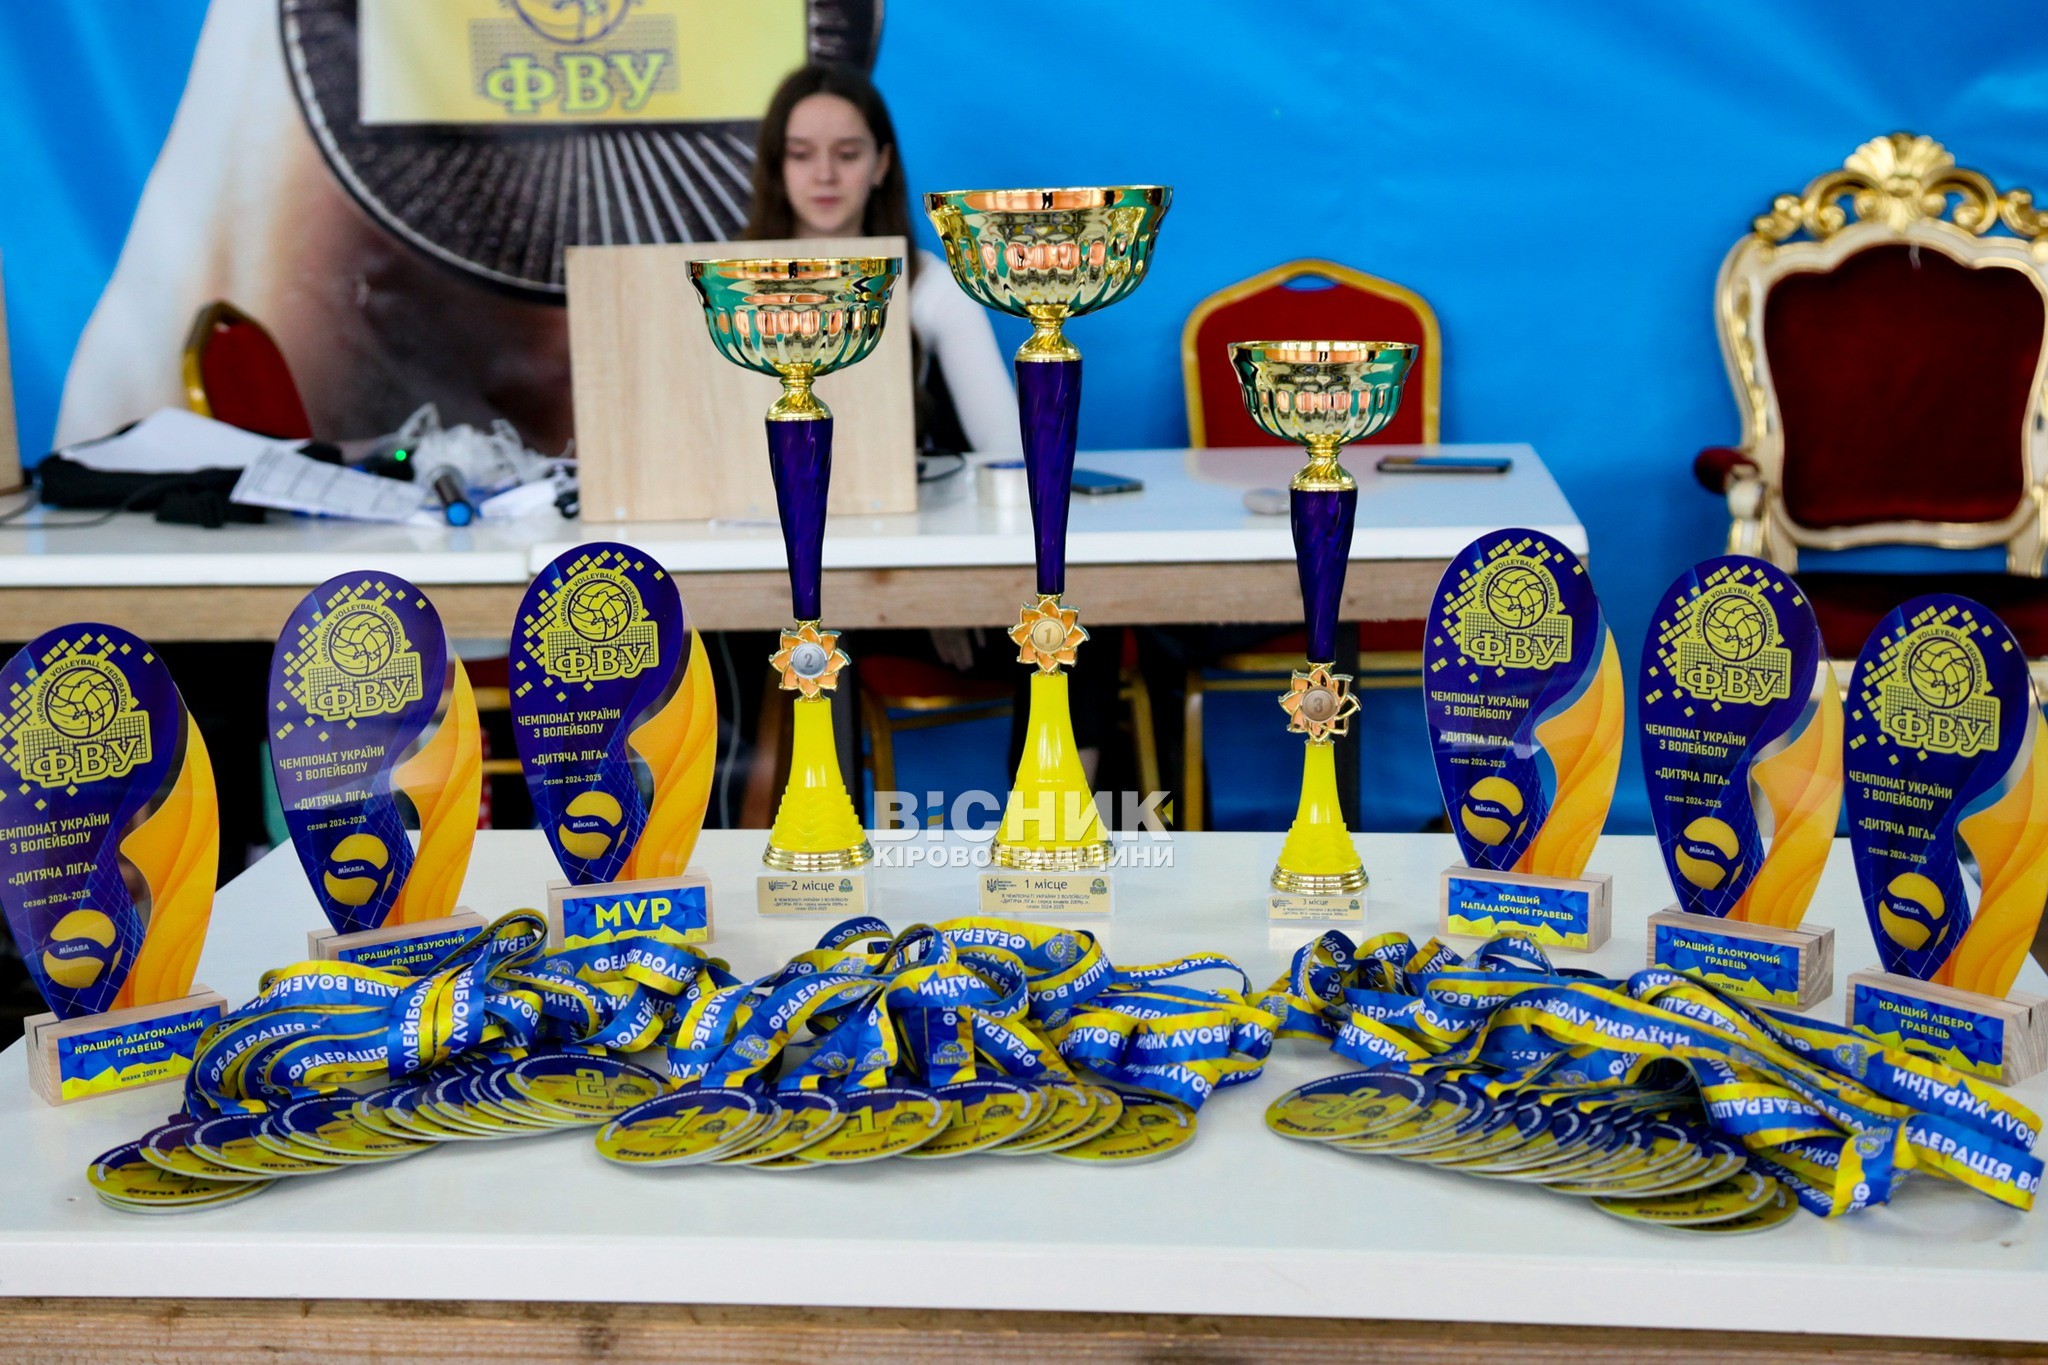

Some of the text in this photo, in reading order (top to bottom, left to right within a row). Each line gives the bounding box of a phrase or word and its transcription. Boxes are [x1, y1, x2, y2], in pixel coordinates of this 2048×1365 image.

[482, 49, 671, 113] ФВУ
[1480, 559, 1555, 614] UKRAINIAN VOLLEYBALL FEDERATION
[561, 572, 639, 627] UKRAINIAN VOLLEYBALL FEDERATION
[1696, 587, 1774, 647] UKRAINIAN VOLLEYBALL FEDERATION
[320, 603, 402, 662] UKRAINIAN VOLLEYBALL FEDERATION
[1045, 628, 1053, 645] 1
[1469, 630, 1563, 665] ФВУ
[555, 642, 650, 678] ФВУ
[803, 652, 814, 670] 2
[1901, 629, 1982, 694] UKRAINIAN VOLLEYBALL FEDERATION
[37, 658, 128, 724] UKRAINIAN VOLLEYBALL FEDERATION
[1685, 662, 1782, 700] ФВУ
[316, 675, 414, 717] ФВУ
[1313, 696, 1324, 714] 3
[1431, 691, 1529, 709] ЧЕМПІОНАТ УКРАЇНИ
[518, 708, 621, 726] ЧЕМПІОНАТ УКРАЇНИ
[1454, 706, 1512, 720] ВОЛЕЙБОЛУ
[543, 723, 604, 738] ВОЛЕЙБОЛУ
[1440, 732, 1515, 746] «ДИТЯЧА ЛІГА»
[1646, 724, 1746, 746] ЧЕМПІОНАТ УКРАЇНИ
[1890, 707, 1991, 752] ФВУ
[31, 735, 142, 783] ФВУ
[280, 745, 385, 770] ЧЕМПІОНАТ УКРАЇНИ
[531, 749, 608, 766] «ДИТЯЧА ЛІГА»
[1669, 741, 1729, 758] ВОЛЕЙБОЛУ
[305, 762, 368, 780] ВОЛЕЙБОЛУ
[1471, 758, 1506, 768] 2024-2025
[543, 774, 602, 785] сезон 2024-2025
[1655, 767, 1731, 786] «ДИТЯЧА ЛІГА»
[1849, 770, 1953, 799] ЧЕМПІОНАТ УКРАЇНИ
[294, 790, 373, 811] «ДИТЯЧА ЛІГА»
[1665, 795, 1722, 808] сезон 2024-2025
[1872, 789, 1934, 811] ВОЛЕЙБОЛУ
[0, 813, 110, 841] ЕМПІОНАТ УКРАЇНИ
[307, 815, 367, 831] сезон 2024-2025
[1858, 817, 1936, 841] «ДИТЯЧА ЛІГА»
[20, 831, 91, 853] ВОЛЕЙБОЛУ
[1868, 846, 1928, 864] сезон 2024-2025
[8, 862, 98, 886] «ДИТЯЧА ЛІГА»
[1025, 879, 1030, 889] 1
[1035, 879, 1068, 891] місце
[792, 880, 797, 891] 2
[802, 880, 835, 892] місце
[23, 889, 91, 908] сезон 2024-2025
[1308, 898, 1328, 906] місце
[1498, 893, 1540, 905] КРАЩИЙ
[595, 897, 672, 928] MVP
[1461, 901, 1574, 920] НАПАДАЮЧИЙ ГРАВЕЦЬ
[357, 948, 400, 962] КРАЩИЙ
[391, 953, 434, 967] ГРАВЕЦЬ
[1673, 939, 1781, 965] КРАЩИЙ БЛОКУЮЧИЙ
[1705, 956, 1747, 970] ГРАВЕЦЬ
[354, 976, 403, 998] АЦІЯ
[1879, 1000, 1974, 1032] КРАЩИЙ ЛІБЕРО
[1593, 1014, 1691, 1047] УКРАЇНИ
[1900, 1019, 1950, 1039] ГРАВЕЦЬ
[75, 1036, 123, 1054] КРАЩИЙ
[117, 1041, 165, 1057] ГРАВЕЦЬ
[210, 1022, 306, 1083] ФЕДЕРАЦІЯ
[142, 1069, 157, 1078] 2009
[288, 1045, 389, 1080] ФЕДЕРАЦІЯ
[575, 1067, 610, 1099] 2
[1892, 1067, 1990, 1120] УКРАЇНИ
[650, 1105, 704, 1137] 1
[846, 1105, 887, 1138] 1
